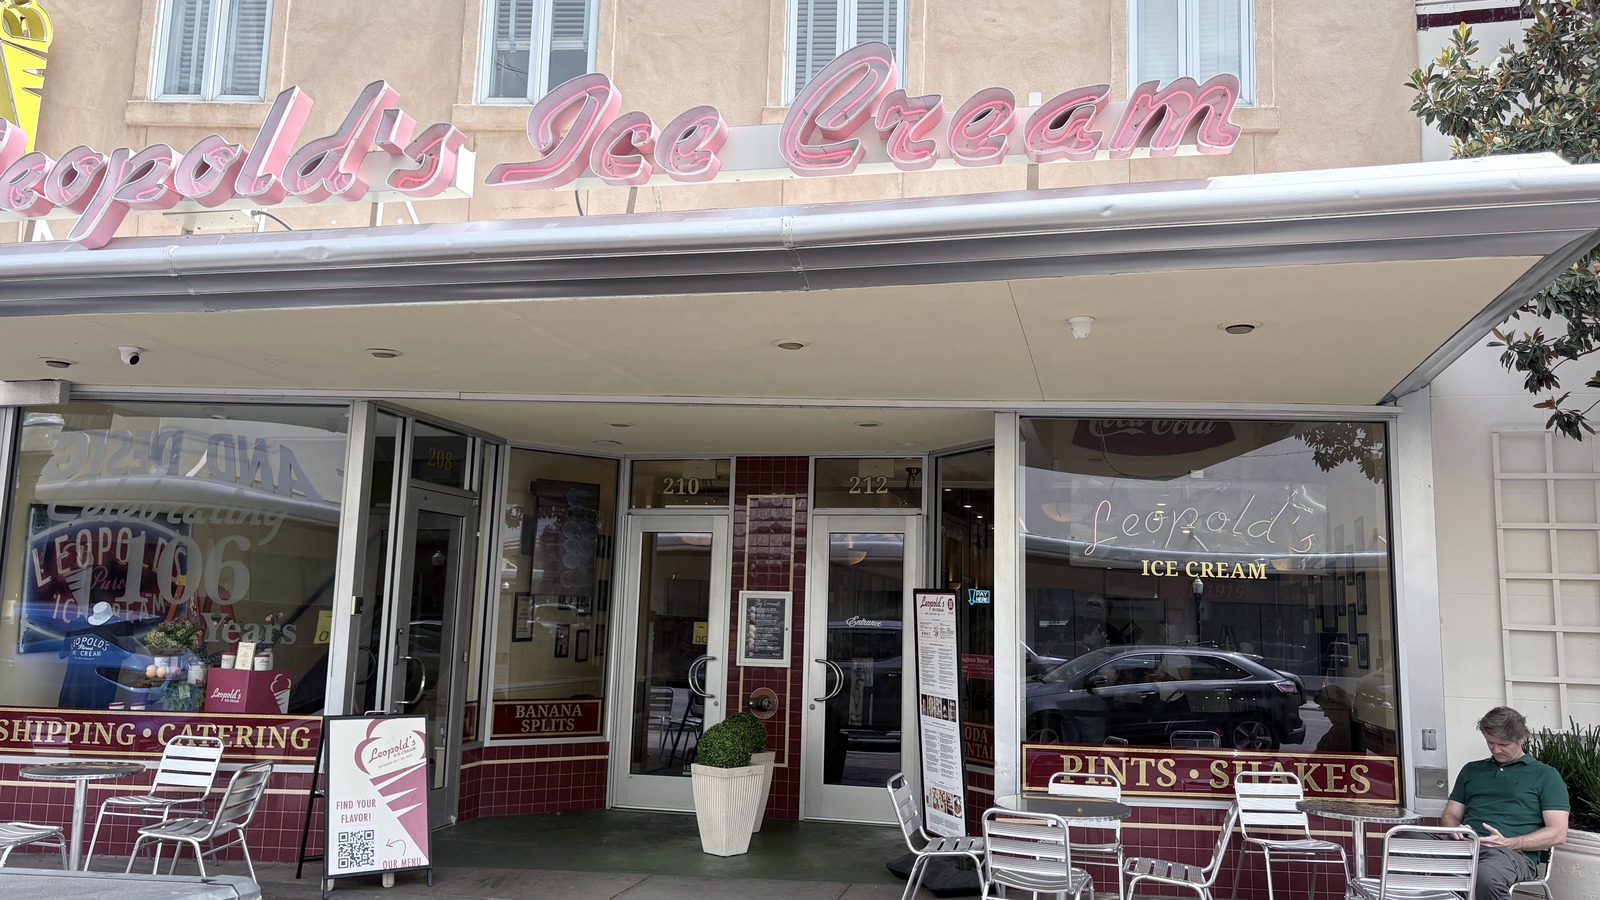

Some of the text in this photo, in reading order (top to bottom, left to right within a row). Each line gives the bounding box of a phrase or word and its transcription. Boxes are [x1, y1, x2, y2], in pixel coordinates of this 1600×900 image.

[0, 40, 1242, 249] eopold's Ice Cream
[427, 447, 453, 471] 208
[663, 477, 700, 495] 210
[849, 476, 888, 494] 212
[1085, 494, 1315, 556] Leopold's
[115, 530, 250, 605] 106
[1141, 559, 1268, 580] ICE CREAM
[200, 611, 298, 646] Years
[845, 615, 883, 628] Entrance
[210, 687, 242, 702] Leopold's
[515, 704, 583, 719] BANANA
[0, 719, 311, 750] SHIPPING CATERING
[520, 718, 575, 733] SPLITS
[964, 726, 988, 743] ODA
[368, 735, 417, 764] Leopold's
[1060, 754, 1372, 795] PINTS SHAKES
[336, 799, 377, 810] FIND YOUR
[341, 812, 372, 824] FLAVOR!
[382, 857, 422, 870] OUR MENU
